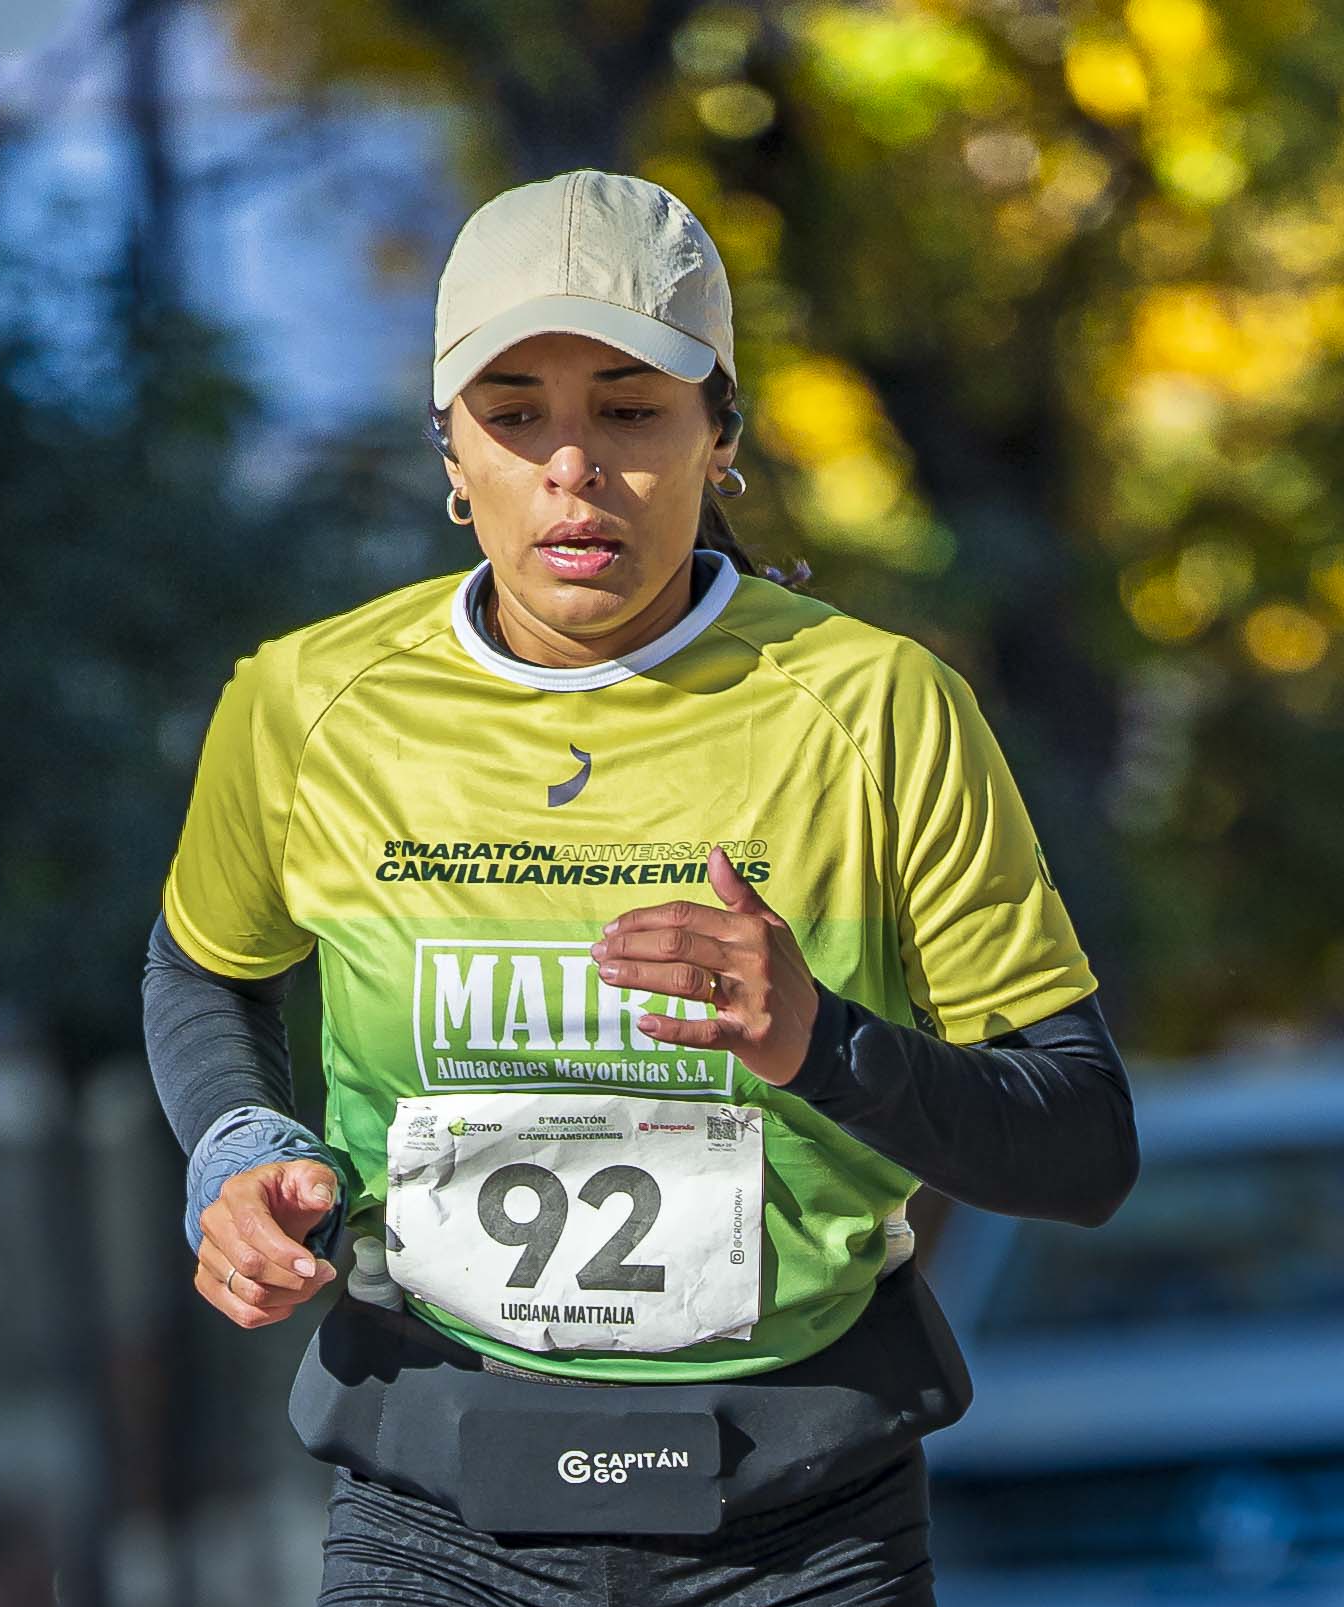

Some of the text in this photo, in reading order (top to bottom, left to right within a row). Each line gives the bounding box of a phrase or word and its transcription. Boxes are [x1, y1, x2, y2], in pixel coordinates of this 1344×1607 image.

[437, 1057, 714, 1083] Almacenes Mayoristas S.A.
[477, 1162, 665, 1292] 92
[501, 1303, 635, 1324] LUCIANA MATTALIA
[593, 1448, 688, 1468] CAPITÁN
[594, 1468, 627, 1484] GO
